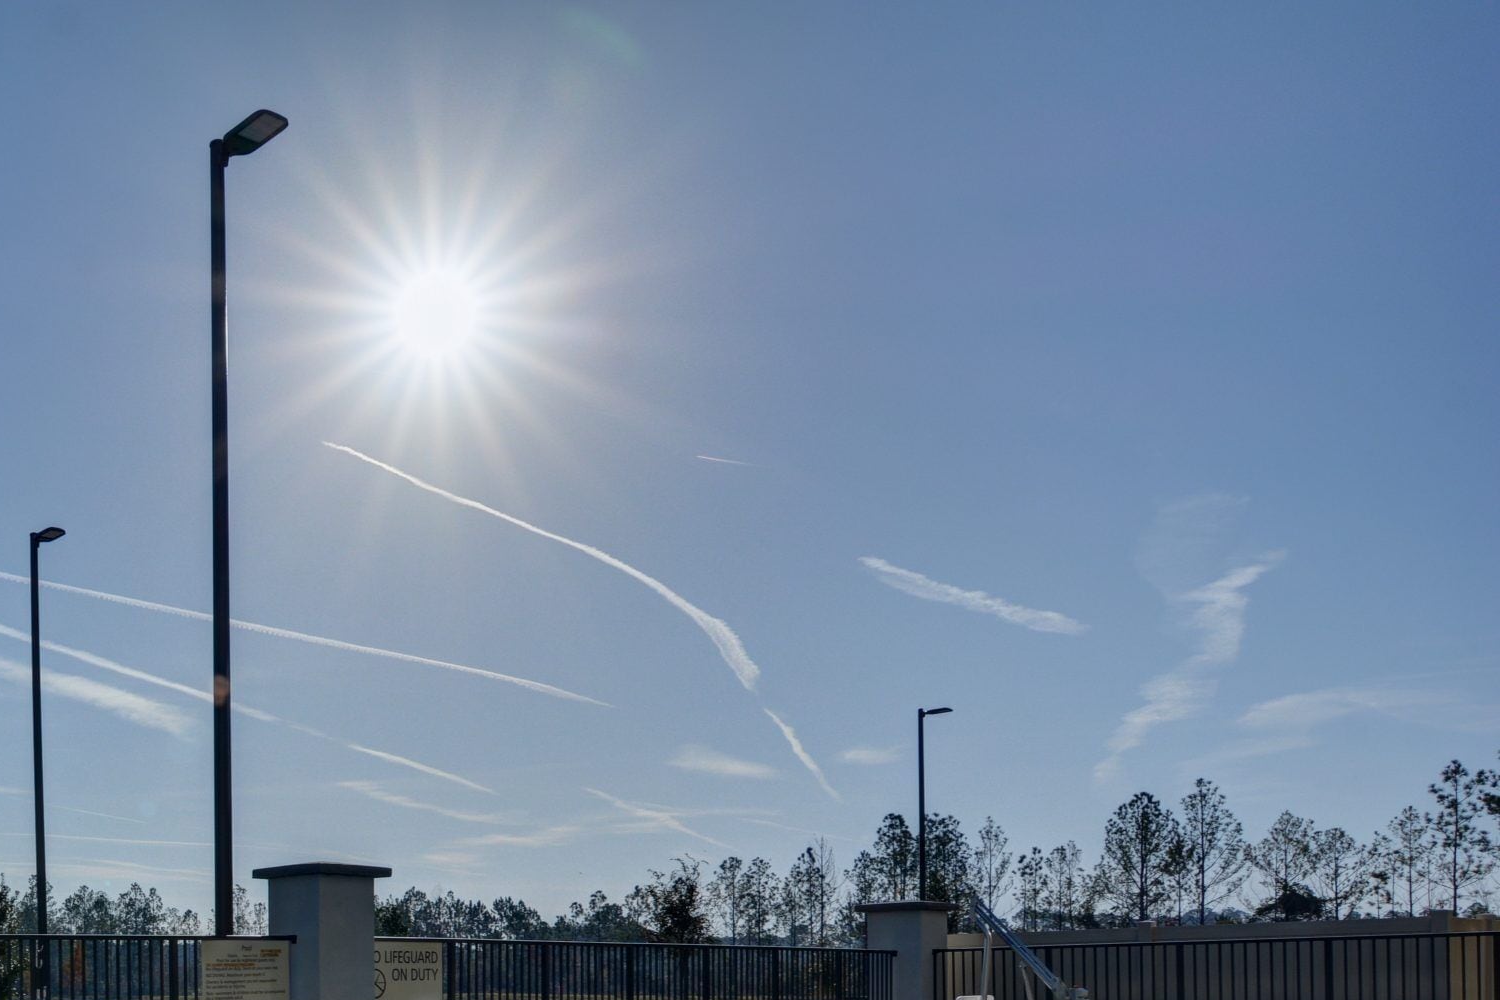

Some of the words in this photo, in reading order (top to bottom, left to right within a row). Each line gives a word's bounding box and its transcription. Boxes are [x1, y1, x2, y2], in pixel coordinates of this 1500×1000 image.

[374, 950, 381, 964] O
[384, 950, 438, 964] LIFEGUARD
[392, 968, 408, 981] ON
[411, 968, 439, 981] DUTY
